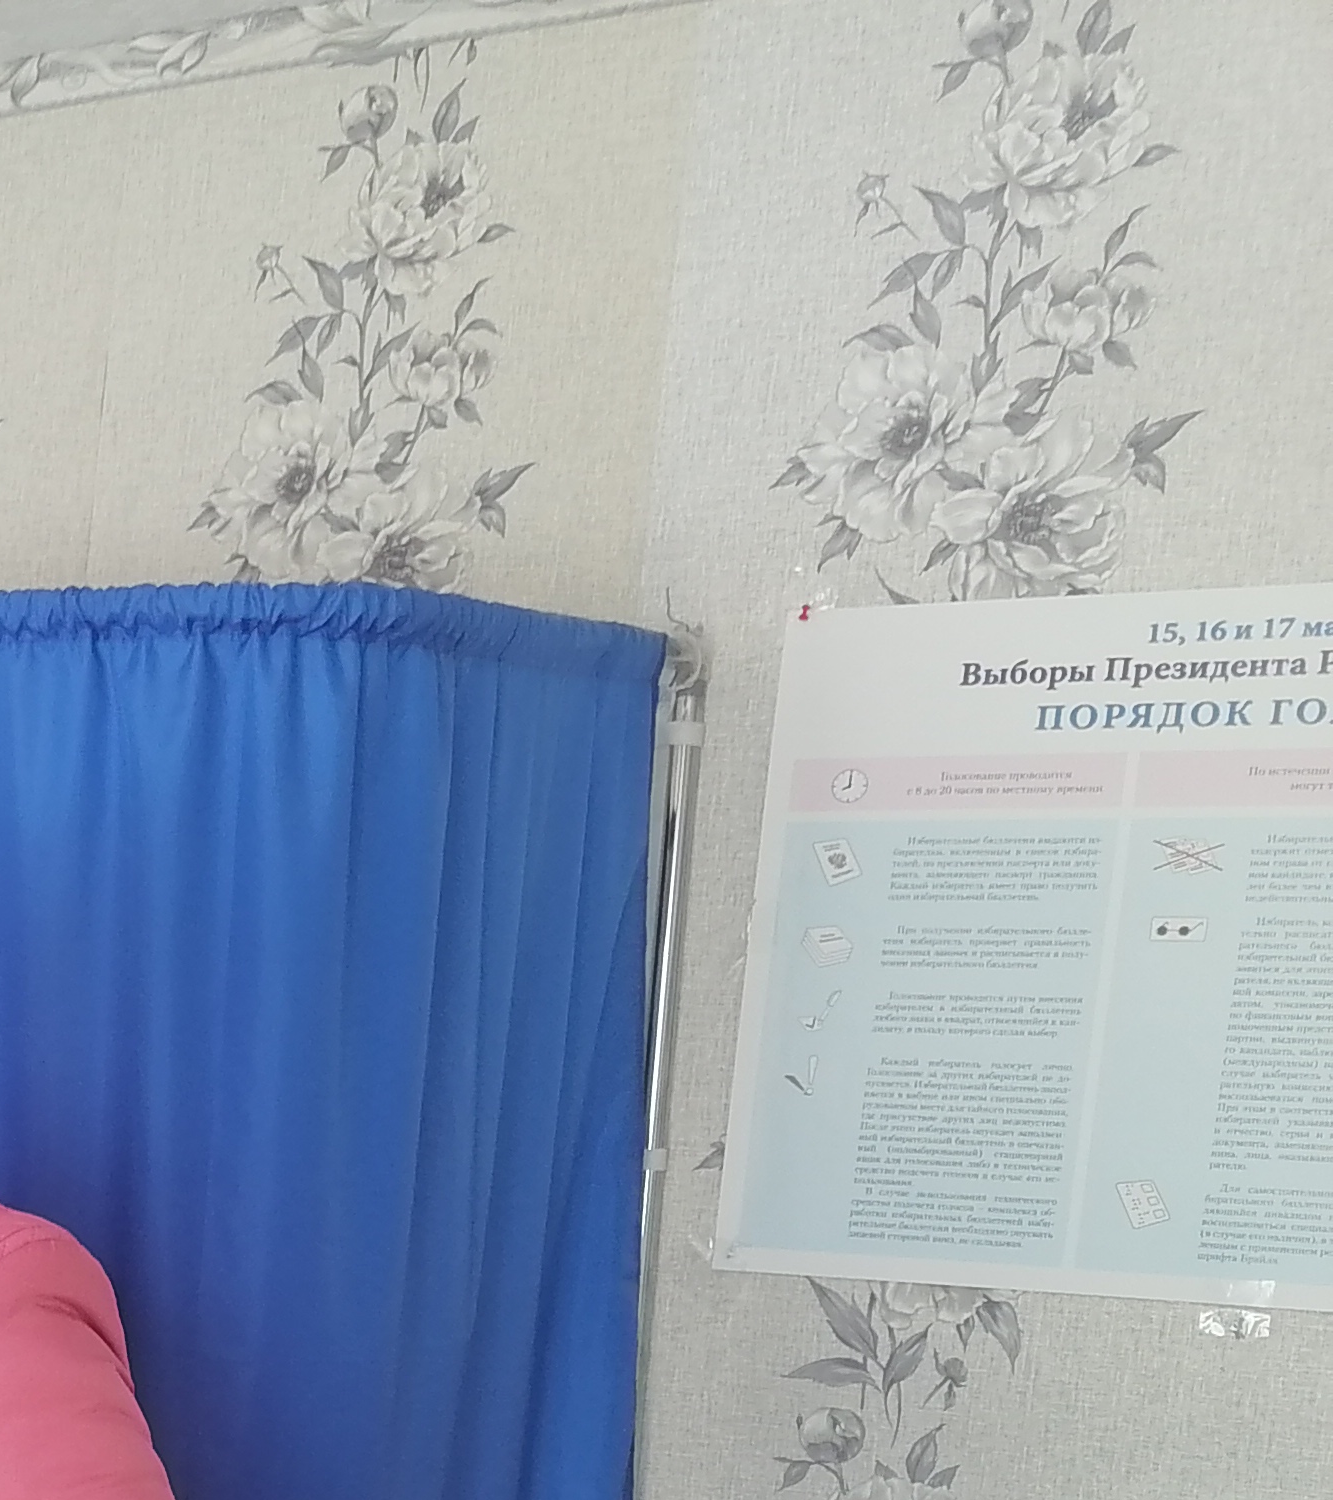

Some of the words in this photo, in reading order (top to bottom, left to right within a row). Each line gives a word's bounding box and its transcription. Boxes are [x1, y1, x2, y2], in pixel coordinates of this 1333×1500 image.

[1148, 622, 1186, 646] 15,
[1195, 619, 1228, 642] 16
[1234, 622, 1253, 641] и
[1263, 617, 1297, 639] 17
[959, 658, 1096, 691] Выборы
[1102, 654, 1308, 688] Президента
[1034, 698, 1255, 734] ПОРЯДОК
